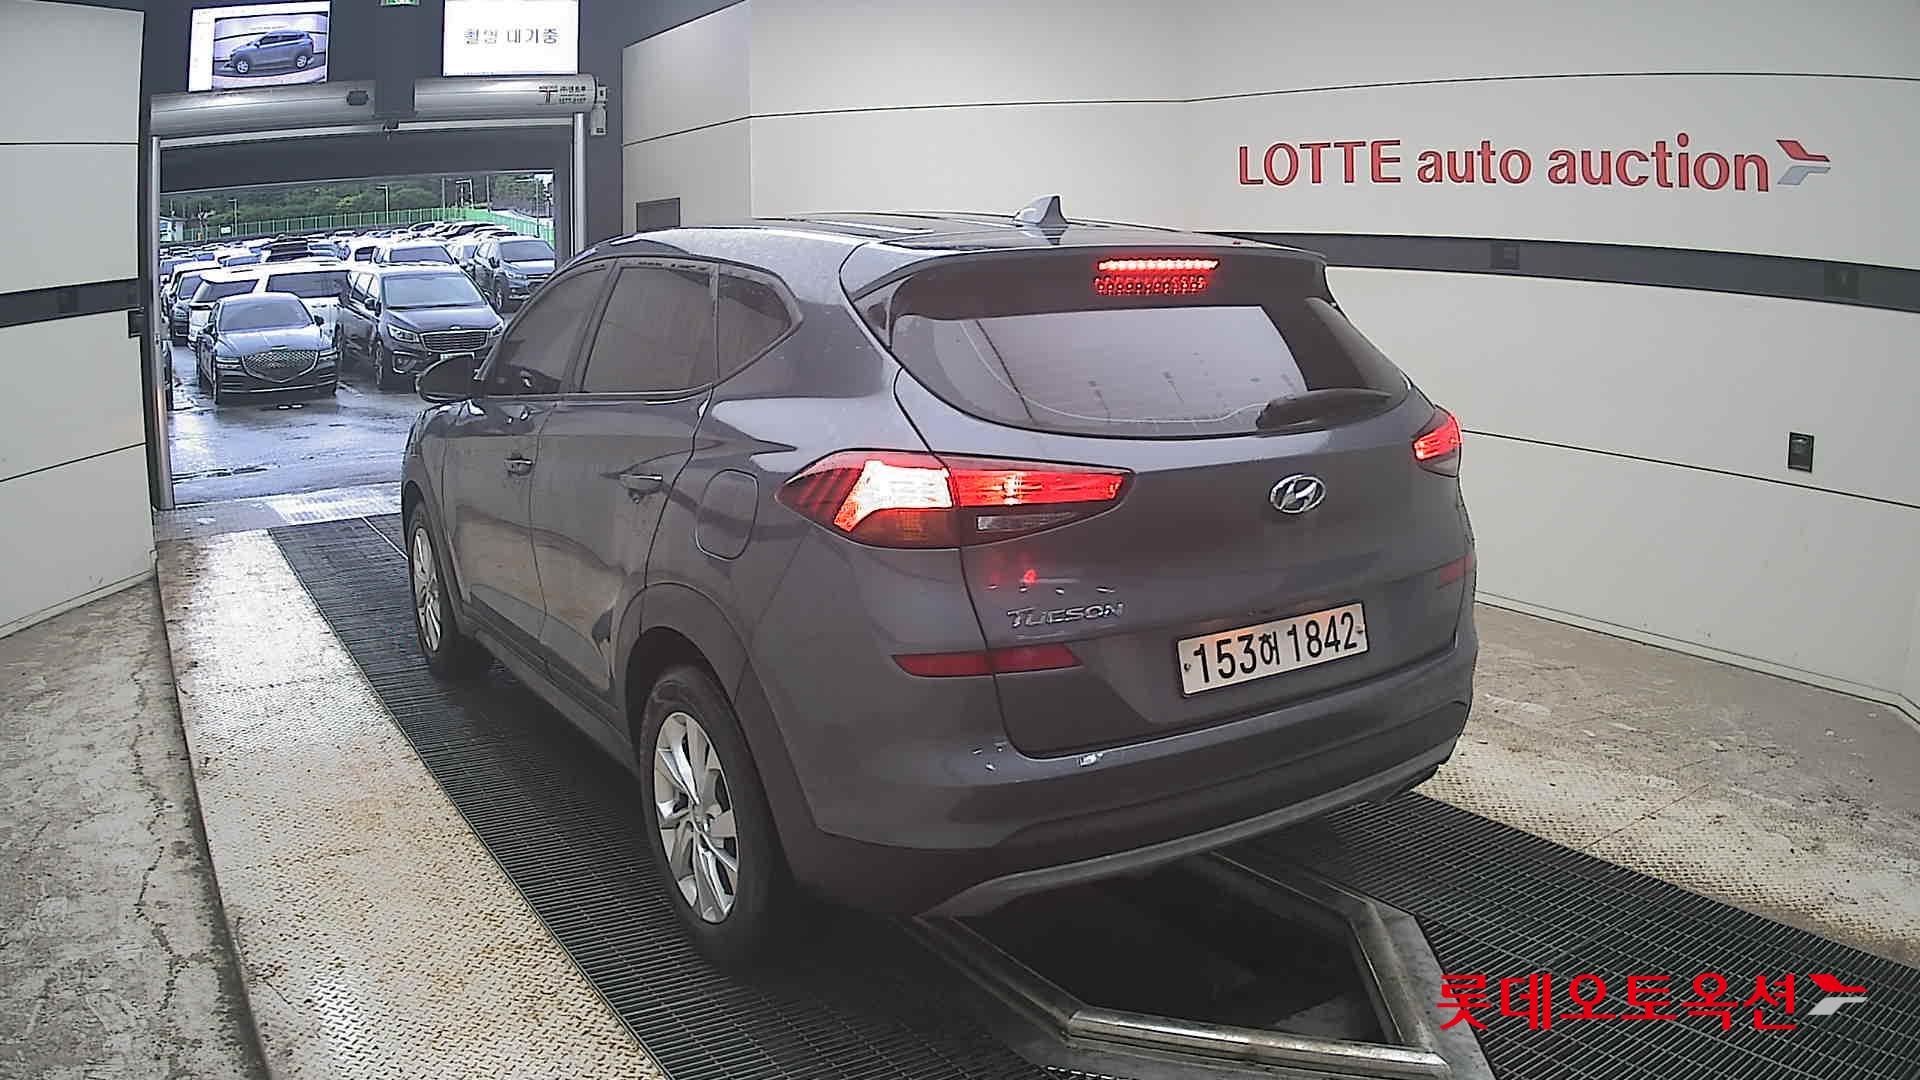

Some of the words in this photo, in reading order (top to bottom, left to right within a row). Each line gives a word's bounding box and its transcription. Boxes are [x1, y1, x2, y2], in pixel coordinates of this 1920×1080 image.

[506, 27, 560, 45] 대기중
[1238, 139, 1402, 186] LOTTE
[1417, 140, 1532, 186] auto
[1547, 133, 1770, 193] auction
[1287, 611, 1358, 663] 1842
